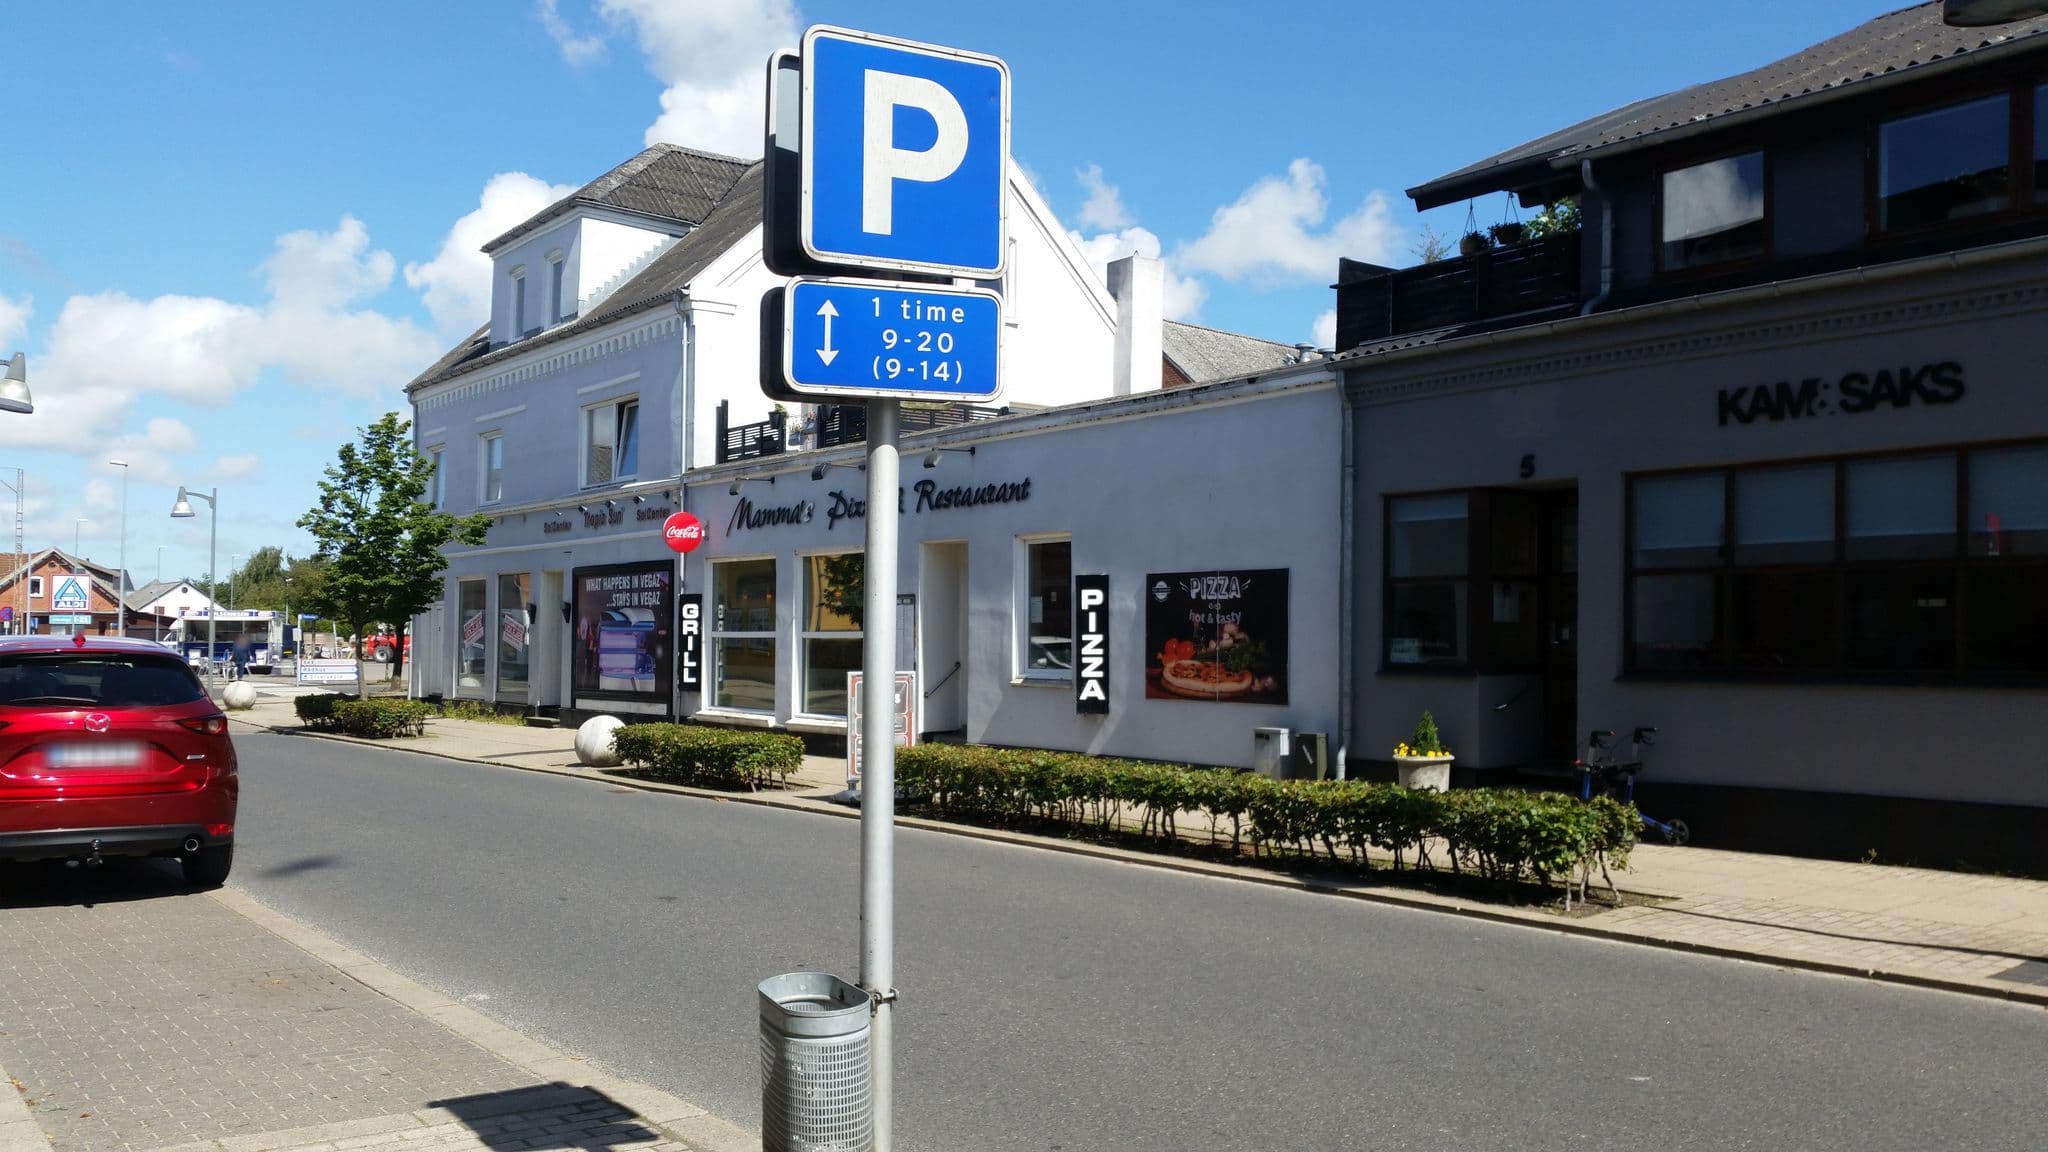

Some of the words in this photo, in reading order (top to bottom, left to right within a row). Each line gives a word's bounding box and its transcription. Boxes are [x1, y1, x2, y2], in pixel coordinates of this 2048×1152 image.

[863, 69, 968, 235] P
[872, 297, 881, 317] 1
[901, 299, 965, 323] time
[882, 329, 954, 353] 9-20
[873, 356, 963, 384] (9-14)
[726, 497, 815, 536] Mamma's
[914, 478, 1031, 513] Restaurant
[586, 578, 601, 592] WHAT
[603, 576, 630, 590] HAPPENS
[632, 576, 639, 588] IN
[1190, 576, 1241, 600] PIZZA
[632, 592, 639, 606] IN
[640, 591, 660, 606] VEGAZ
[1189, 609, 1206, 624] hot
[1216, 611, 1242, 625] tasty
[682, 603, 700, 683] GRILL
[1079, 588, 1106, 701] PIZZA
